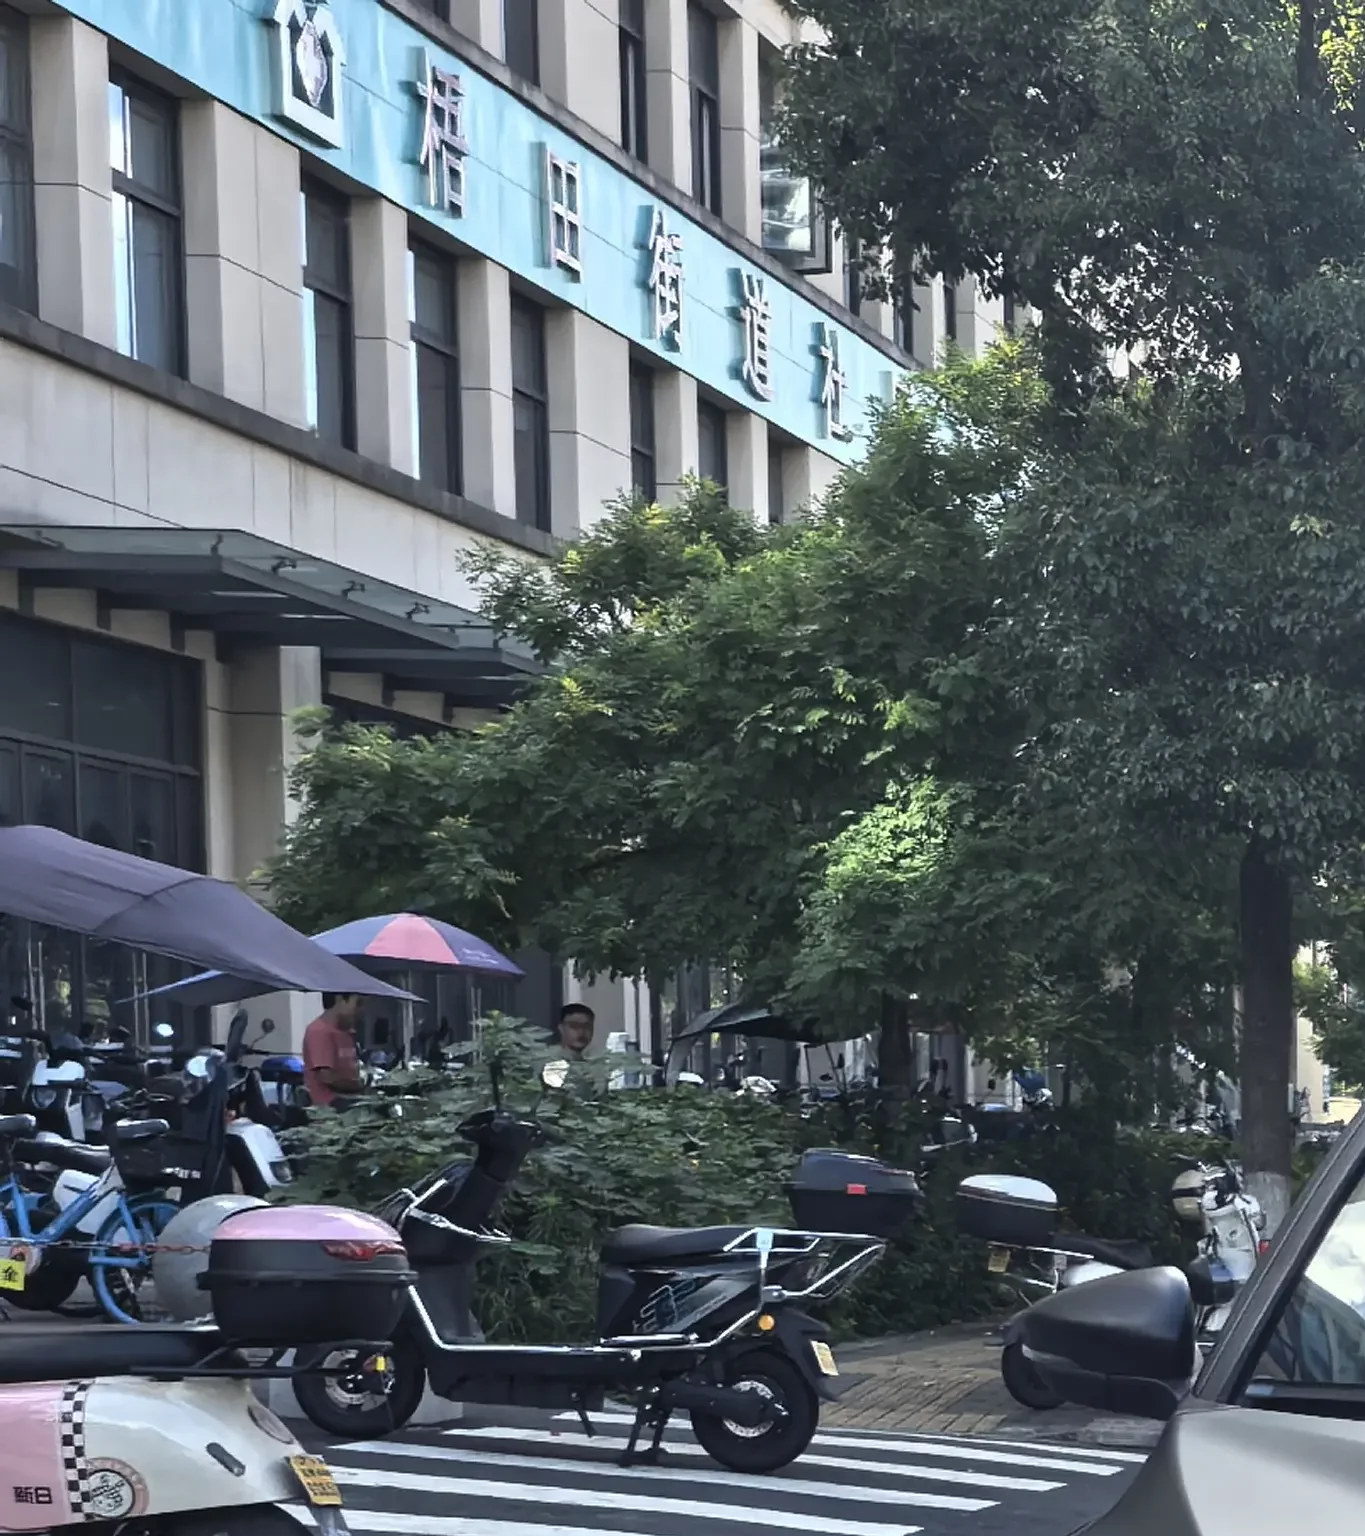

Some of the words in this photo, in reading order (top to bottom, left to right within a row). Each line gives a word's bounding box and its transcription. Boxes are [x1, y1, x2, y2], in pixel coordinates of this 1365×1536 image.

[416, 47, 902, 443] 梧田街道社
[12, 1486, 53, 1505] 新日
